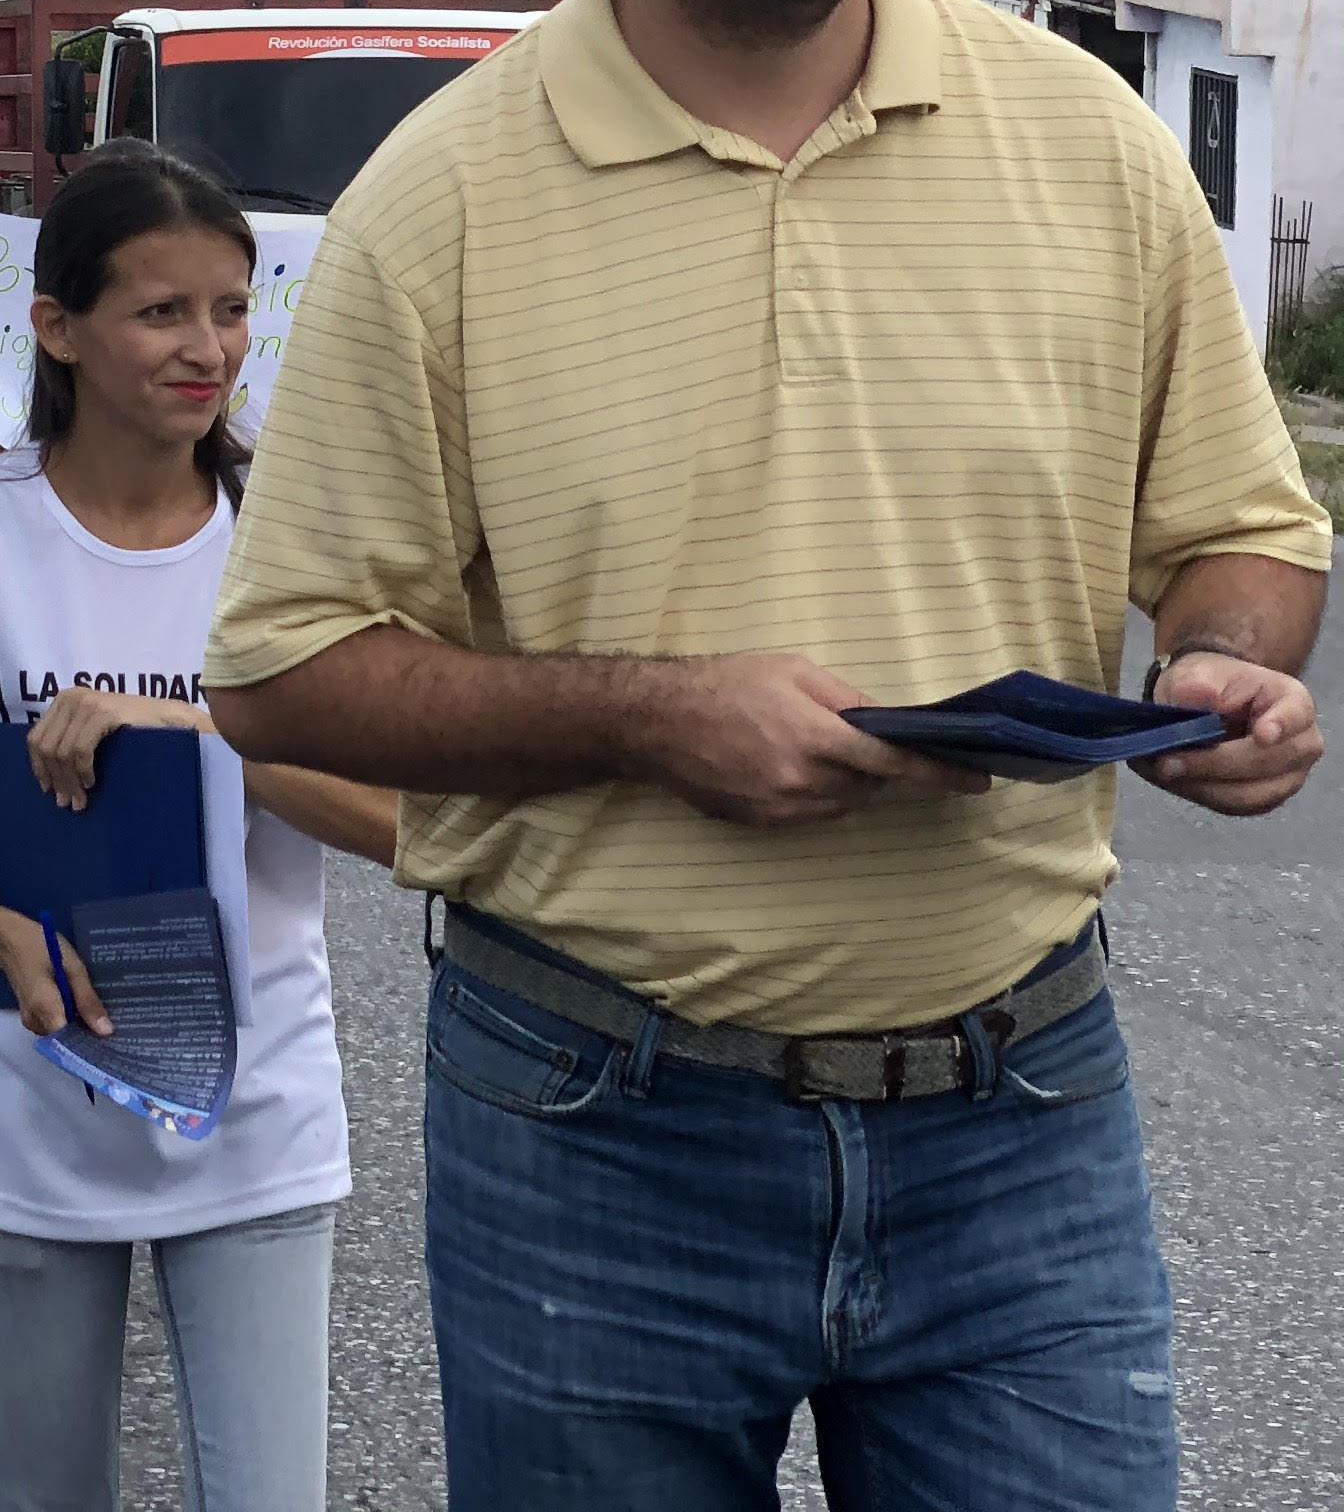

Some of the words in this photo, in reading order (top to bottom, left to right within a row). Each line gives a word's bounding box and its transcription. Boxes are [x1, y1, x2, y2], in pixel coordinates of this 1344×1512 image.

[268, 36, 347, 49] Revolución
[351, 35, 413, 48] Gasífera
[417, 35, 491, 49] Socialista
[19, 670, 59, 702] LA
